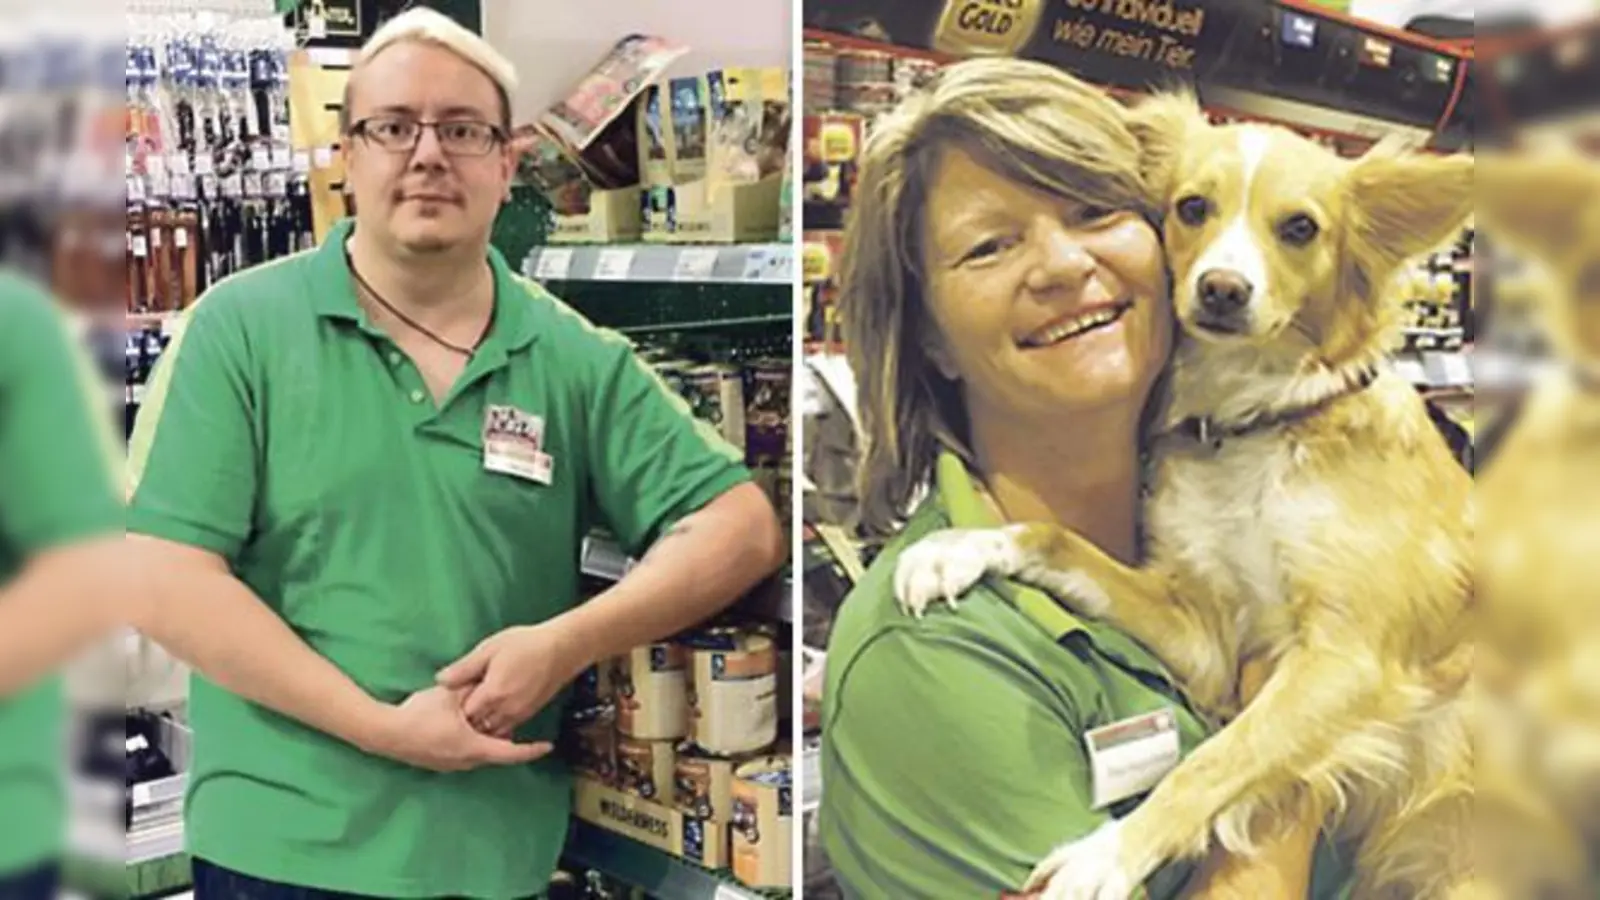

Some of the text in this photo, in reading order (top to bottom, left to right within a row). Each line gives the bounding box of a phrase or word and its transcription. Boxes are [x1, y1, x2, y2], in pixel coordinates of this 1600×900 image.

[958, 3, 1013, 35] GOLD
[1053, 17, 1096, 48] wie
[1096, 28, 1154, 60] mein
